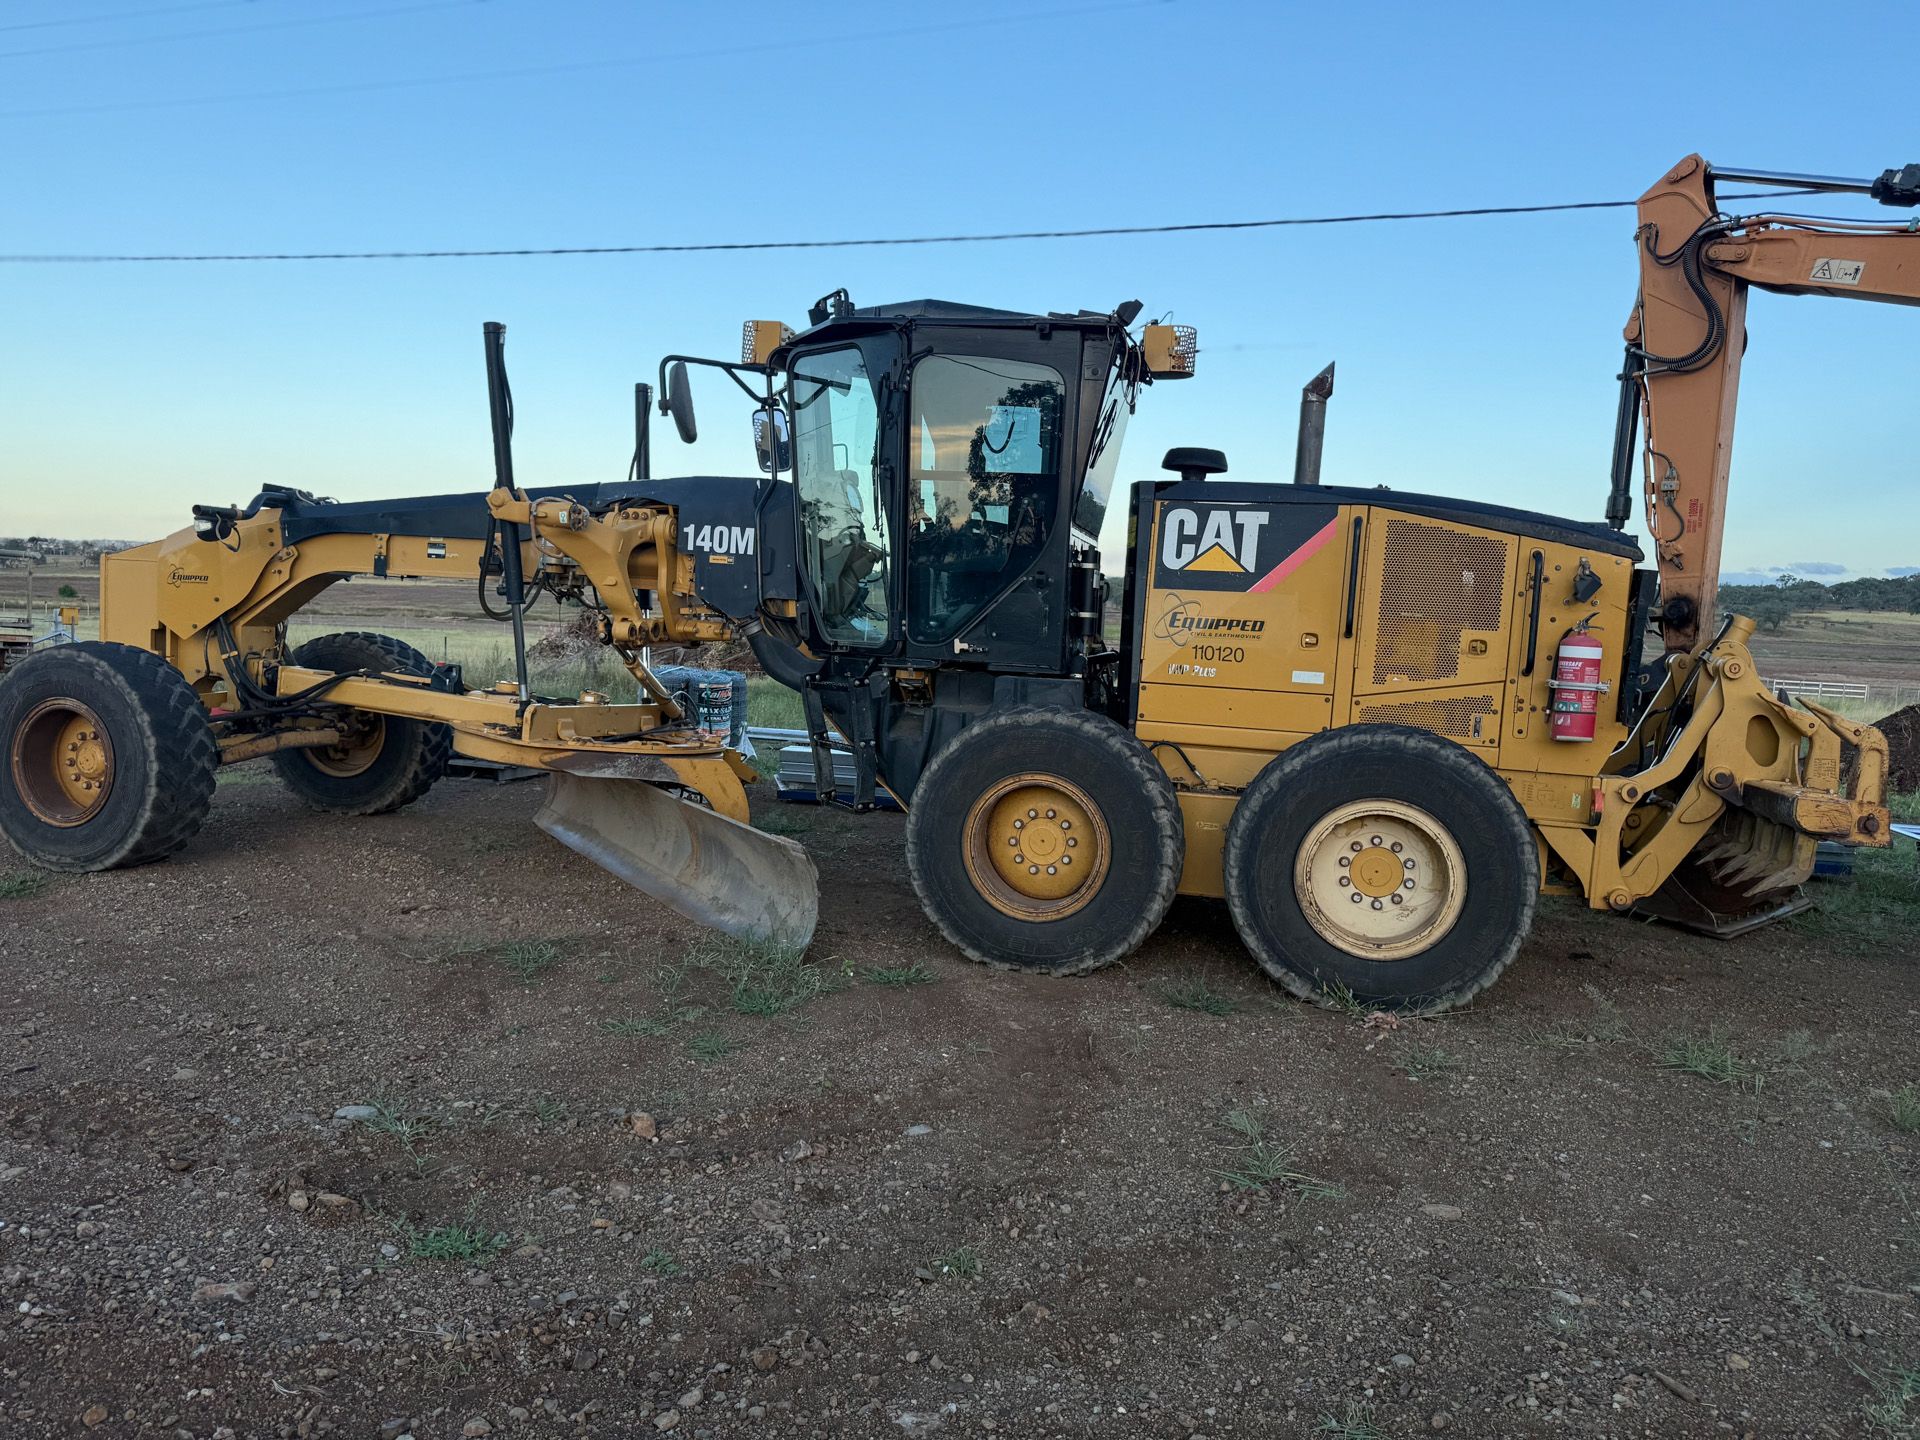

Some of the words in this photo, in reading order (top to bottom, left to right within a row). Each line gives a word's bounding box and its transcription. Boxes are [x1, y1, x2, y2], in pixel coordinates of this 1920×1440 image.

[683, 523, 755, 556] 140M
[1162, 508, 1270, 573] CAT
[1169, 612, 1265, 631] EQUIPPED
[1214, 632, 1261, 640] EARTHMOVING
[1192, 644, 1245, 664] 110120
